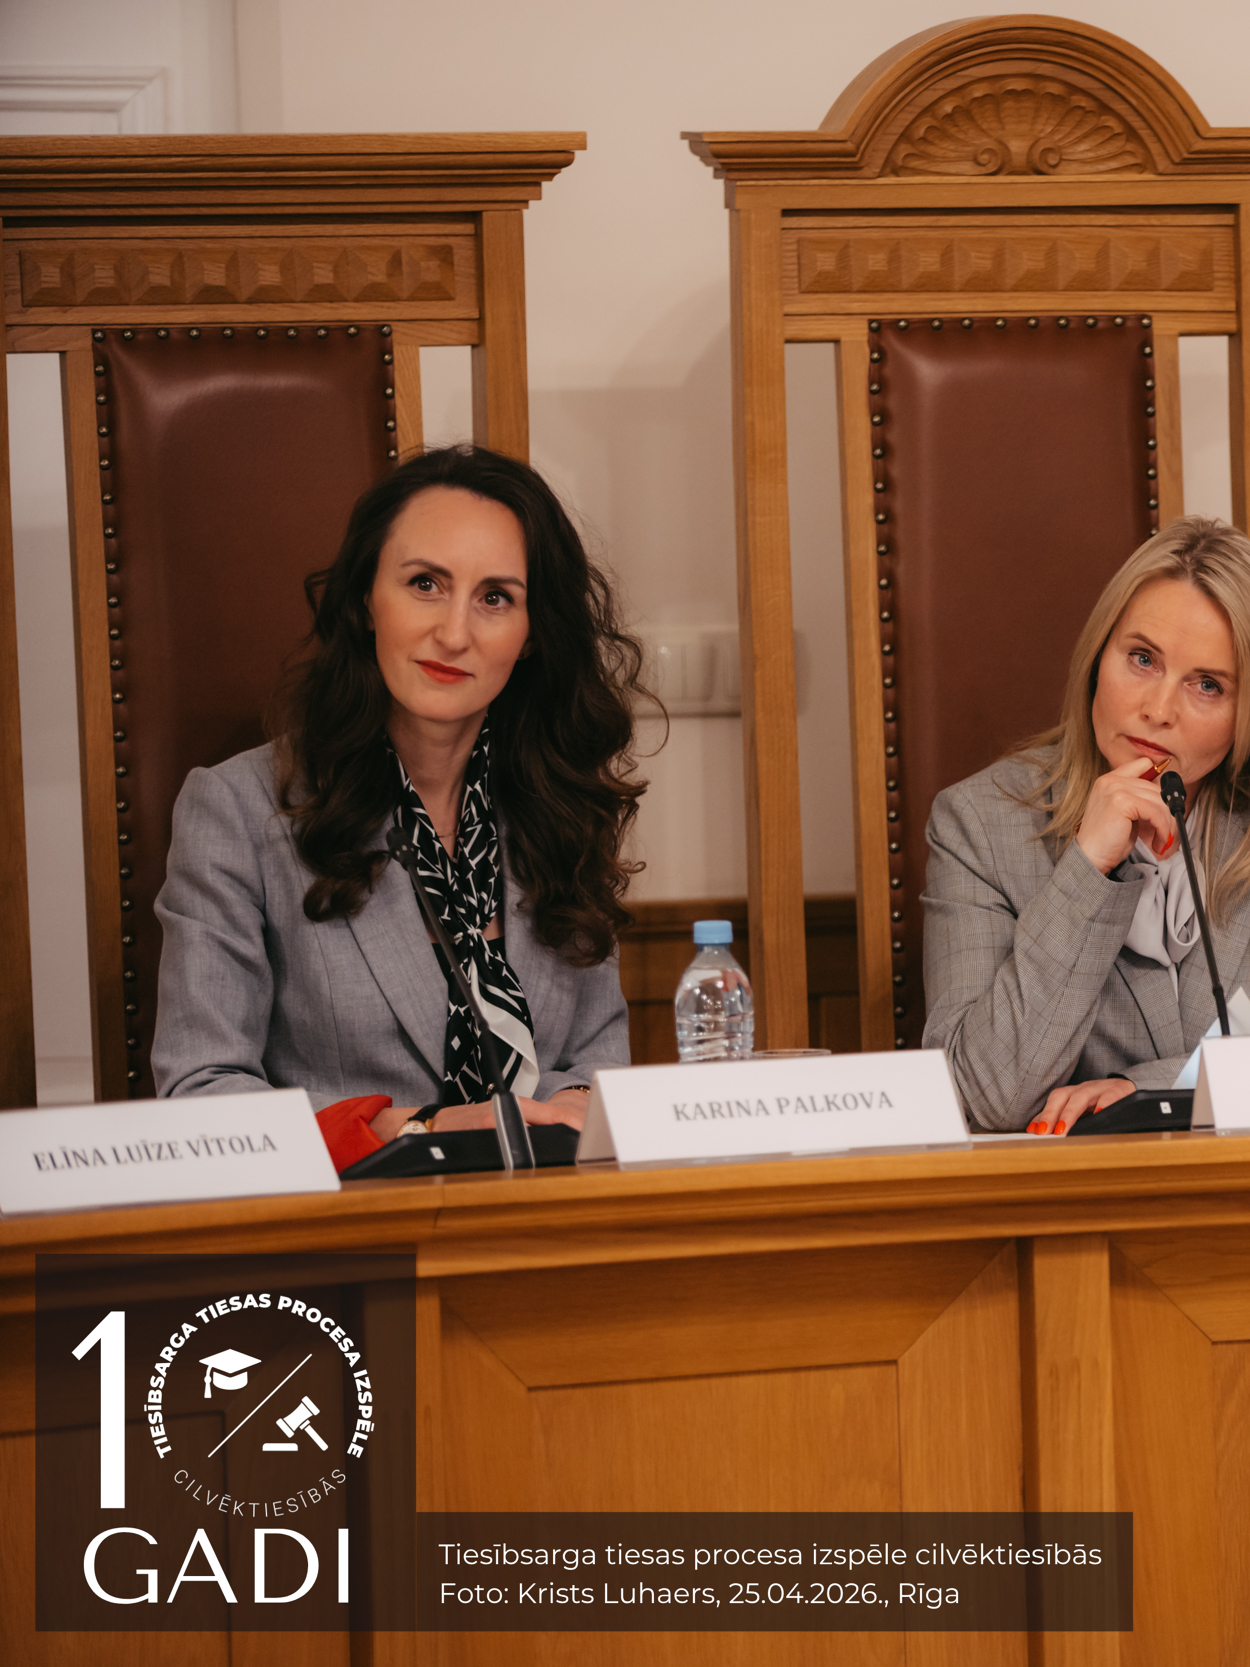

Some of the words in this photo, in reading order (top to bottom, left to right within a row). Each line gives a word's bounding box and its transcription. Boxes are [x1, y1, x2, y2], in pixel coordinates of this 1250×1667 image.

[672, 1098, 770, 1122] KARINA
[775, 1090, 894, 1115] PALKOVA
[33, 1146, 108, 1172] ELĪNA
[111, 1139, 183, 1166] LUĪZE
[185, 1133, 278, 1158] VĪTOLA
